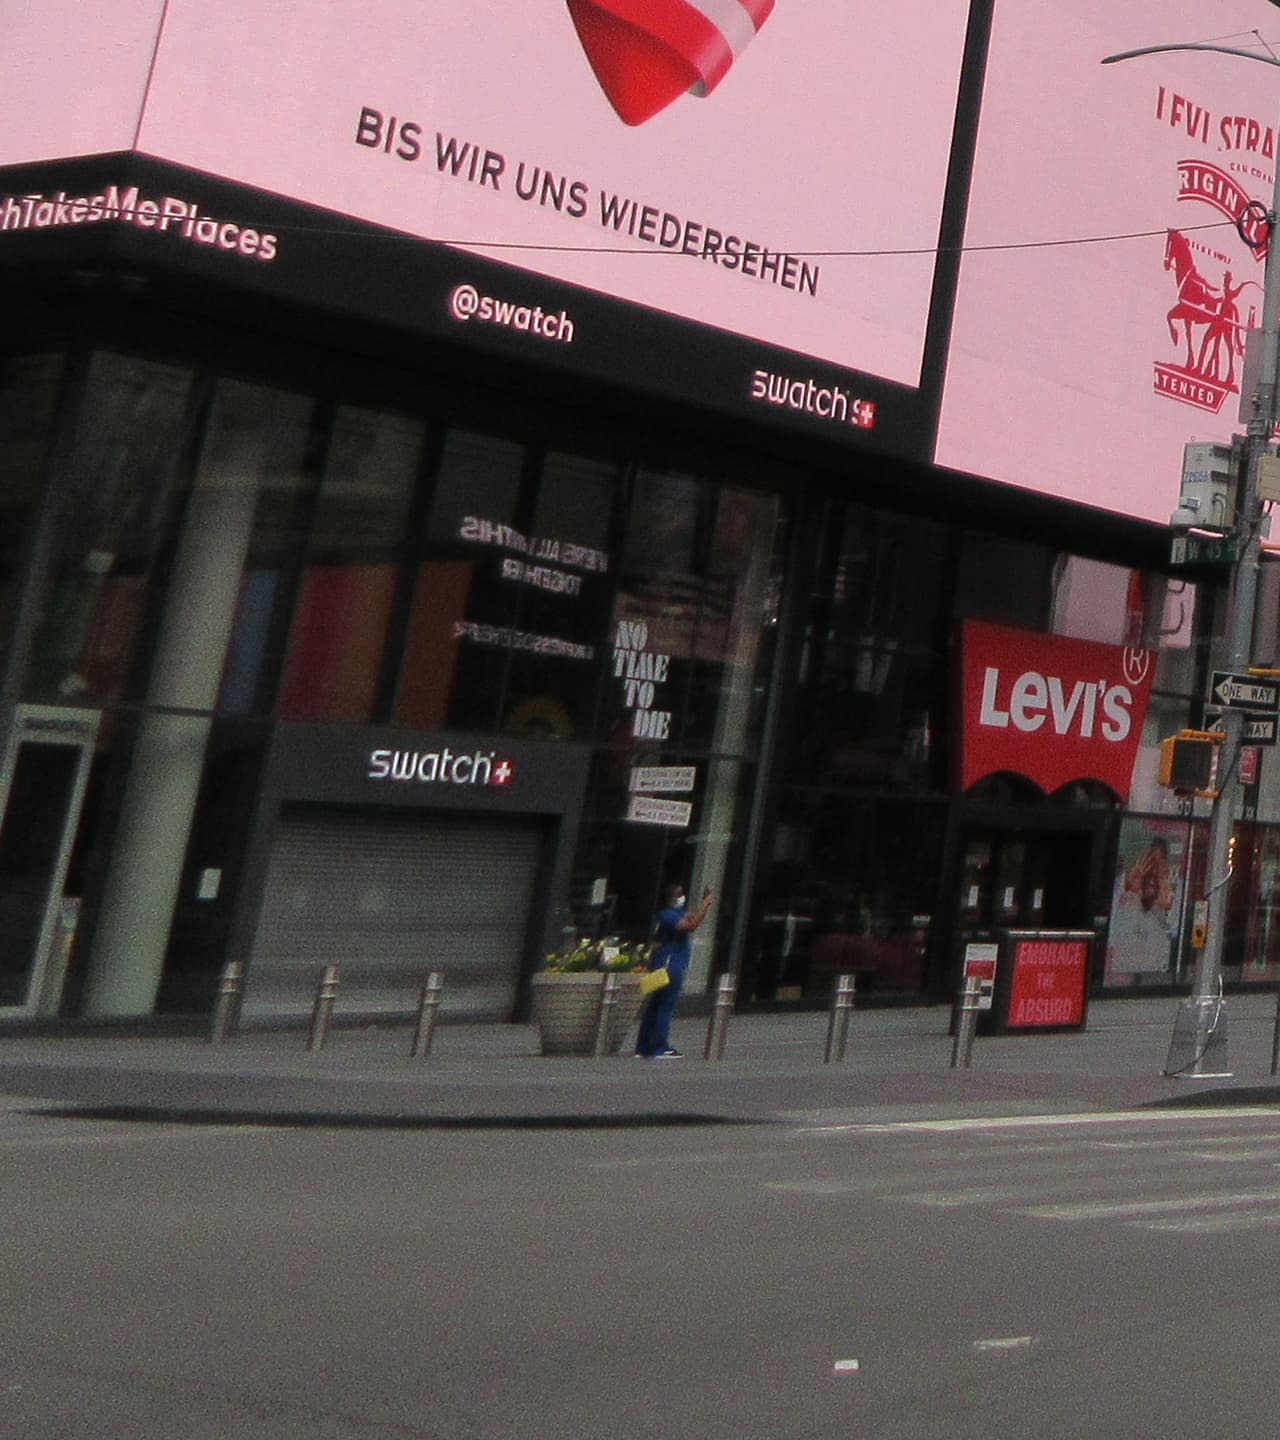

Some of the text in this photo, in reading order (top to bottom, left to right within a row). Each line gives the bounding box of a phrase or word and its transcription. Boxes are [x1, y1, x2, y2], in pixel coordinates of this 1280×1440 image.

[355, 105, 821, 298] BIS WIR UNS WIEDERSEHEN
[0, 185, 279, 261] hTakesMePlaces
[449, 284, 576, 344] @swatch
[752, 370, 850, 423] swatch
[615, 620, 649, 652] NO
[613, 648, 671, 682] TIME
[623, 678, 656, 709] TO
[1222, 682, 1273, 702] ONE WAY
[368, 746, 495, 786] swatch
[1018, 941, 1083, 963] EMBRACE
[1016, 998, 1073, 1023] ABSURD
